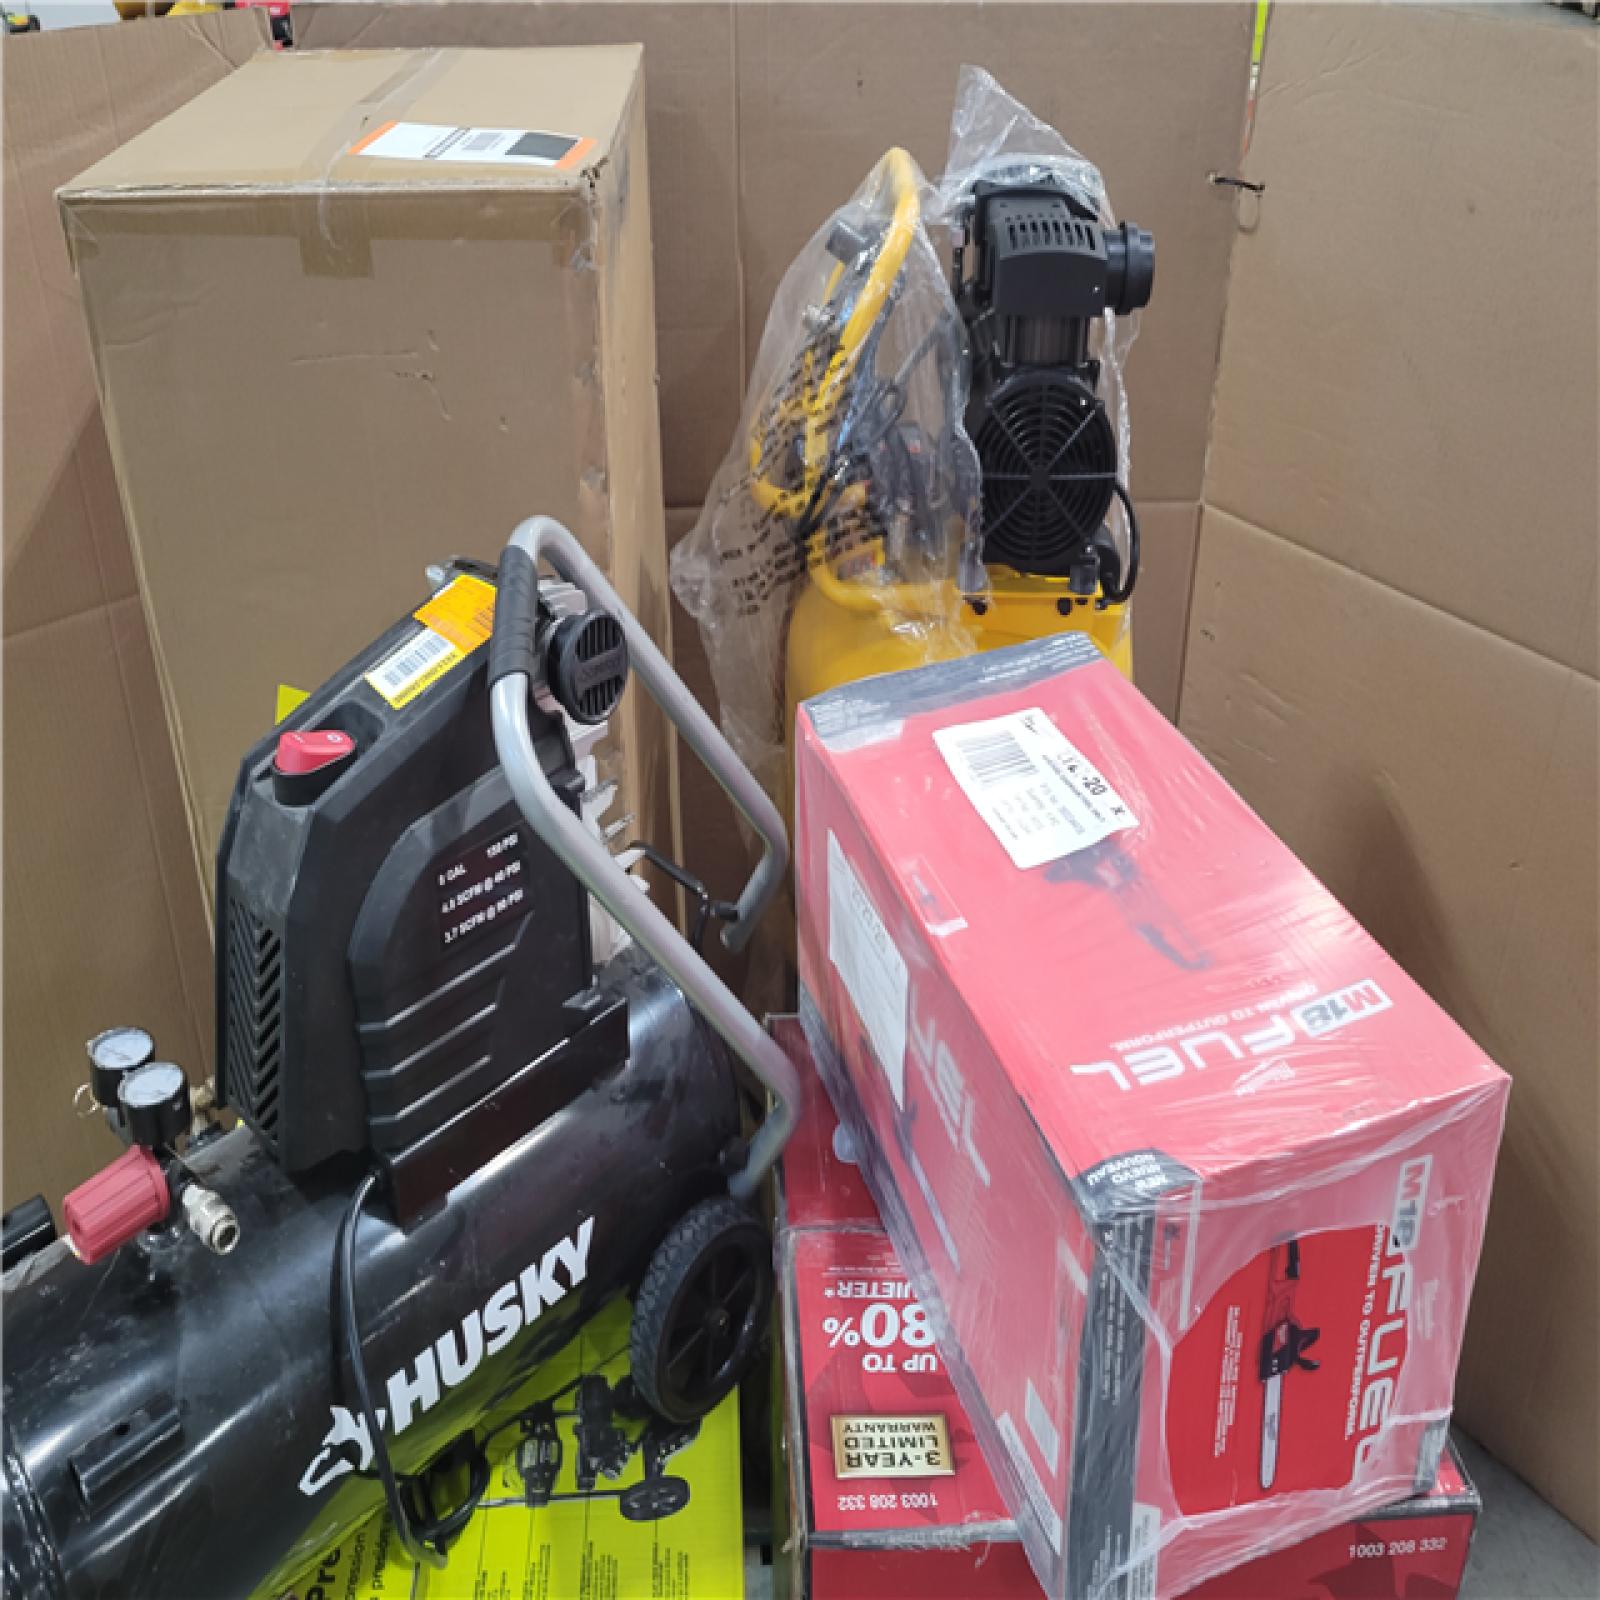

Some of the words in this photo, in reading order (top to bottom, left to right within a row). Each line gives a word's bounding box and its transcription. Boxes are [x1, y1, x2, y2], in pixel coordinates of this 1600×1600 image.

[1300, 982, 1386, 1035] M18
[1069, 1015, 1296, 1091] FUEL
[1392, 1161, 1427, 1250] M18
[387, 1216, 595, 1435] HUSKY
[822, 1302, 936, 1348] 80%
[862, 1353, 896, 1373] TO
[902, 1353, 937, 1373] UP
[1351, 1263, 1414, 1489] FUEL
[843, 1422, 936, 1433] WARRANTY
[844, 1435, 938, 1451] LIMITED
[843, 1450, 941, 1468] 3-YEAR
[837, 1494, 866, 1511] 332
[869, 1494, 898, 1509] 208
[901, 1493, 939, 1509] 1003
[1349, 1542, 1384, 1559] 1003
[1388, 1539, 1416, 1556] 208
[1419, 1536, 1448, 1553] 332
